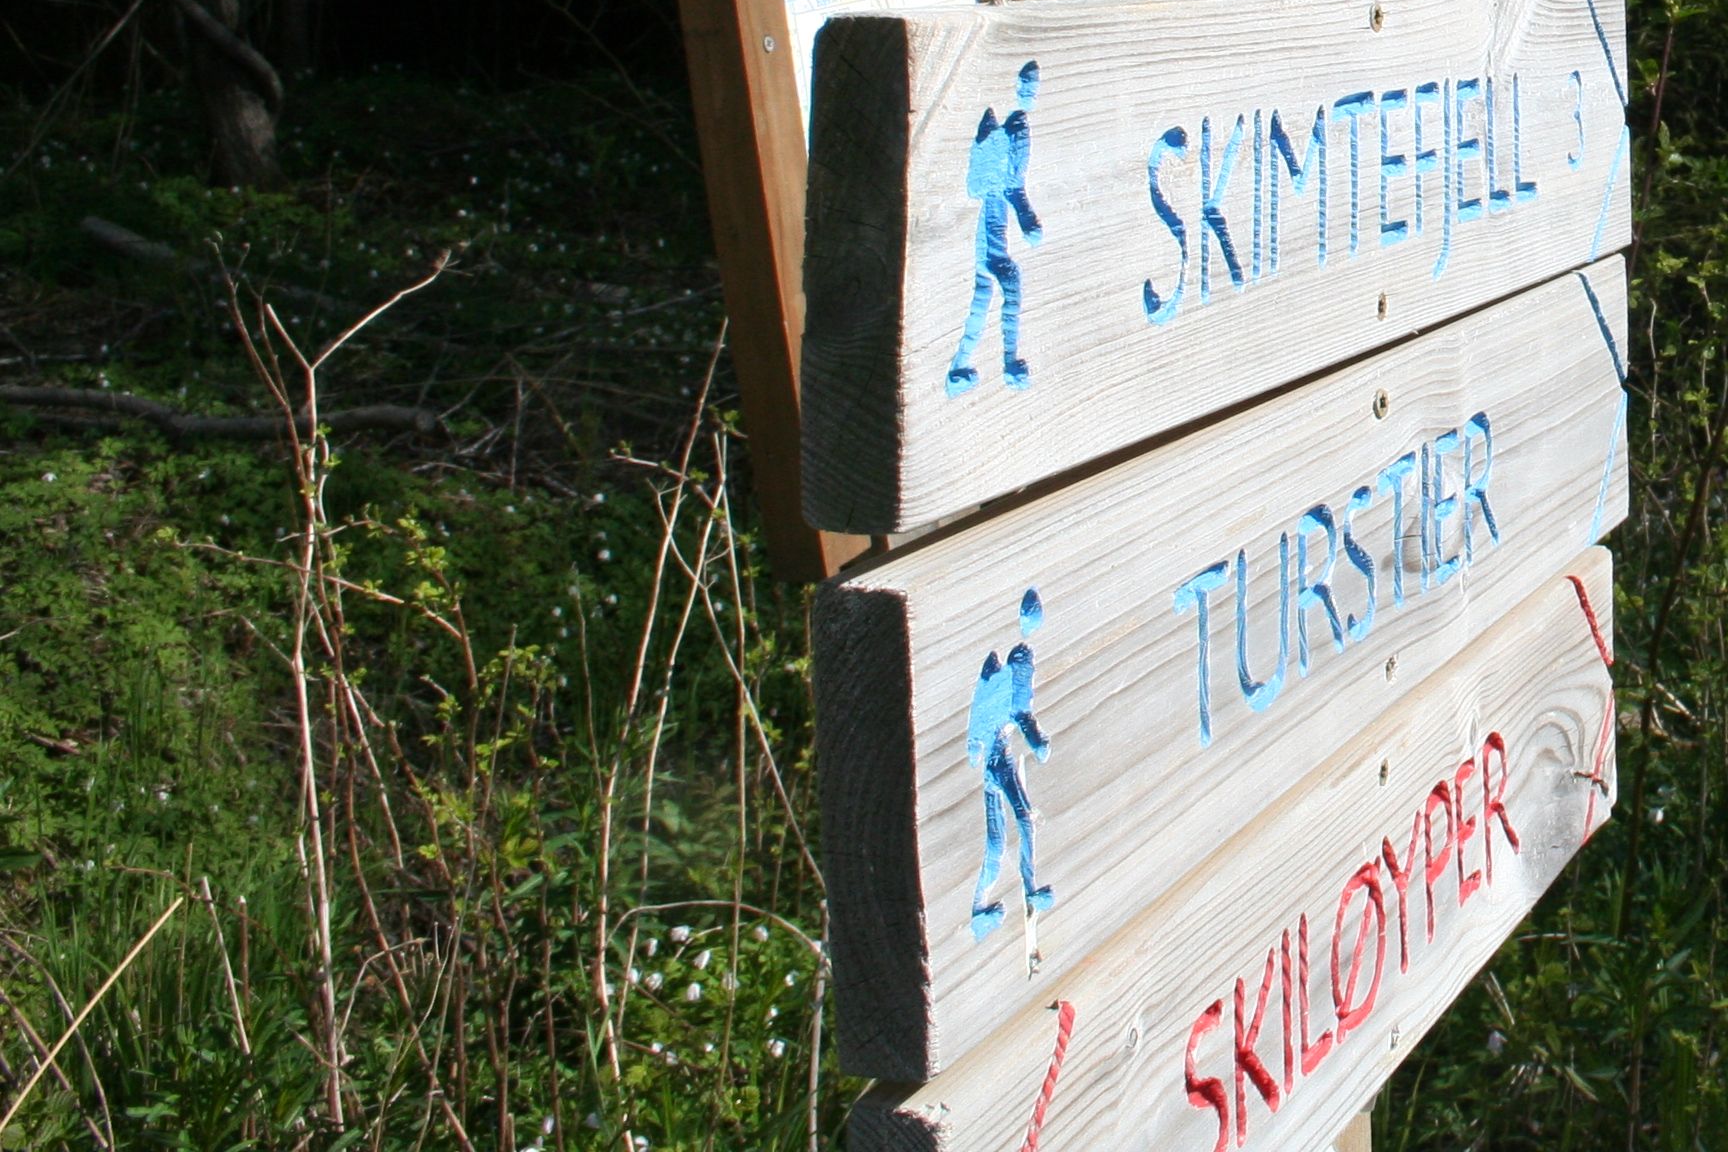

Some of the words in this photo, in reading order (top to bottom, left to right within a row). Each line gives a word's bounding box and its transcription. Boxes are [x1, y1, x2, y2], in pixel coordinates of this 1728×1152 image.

[1142, 73, 1539, 325] SKIMTEFJELL
[1172, 410, 1500, 748] TURSTIER
[1185, 730, 1520, 1152] SKILØYPER
